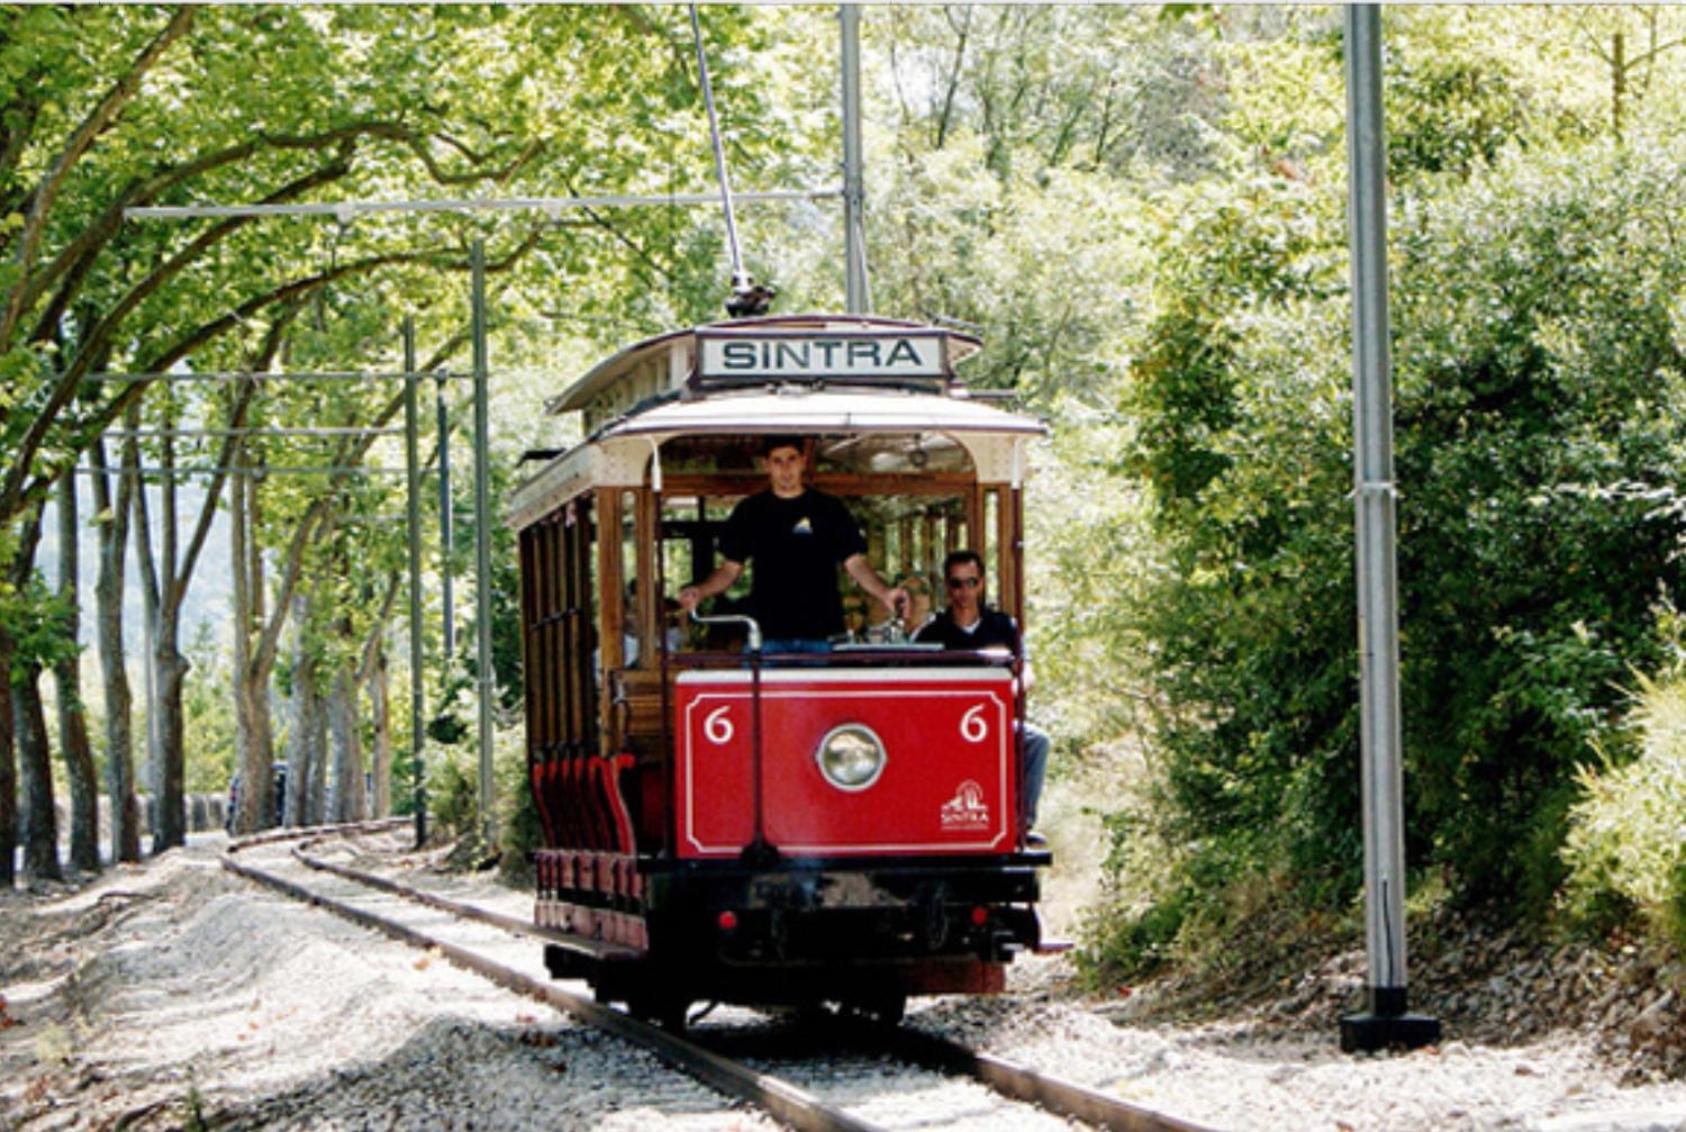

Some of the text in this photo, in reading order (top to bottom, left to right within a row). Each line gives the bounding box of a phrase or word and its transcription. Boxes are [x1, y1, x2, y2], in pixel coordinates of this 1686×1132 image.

[723, 340, 921, 369] SINTRA
[704, 705, 734, 745] 6
[960, 703, 988, 742] 6
